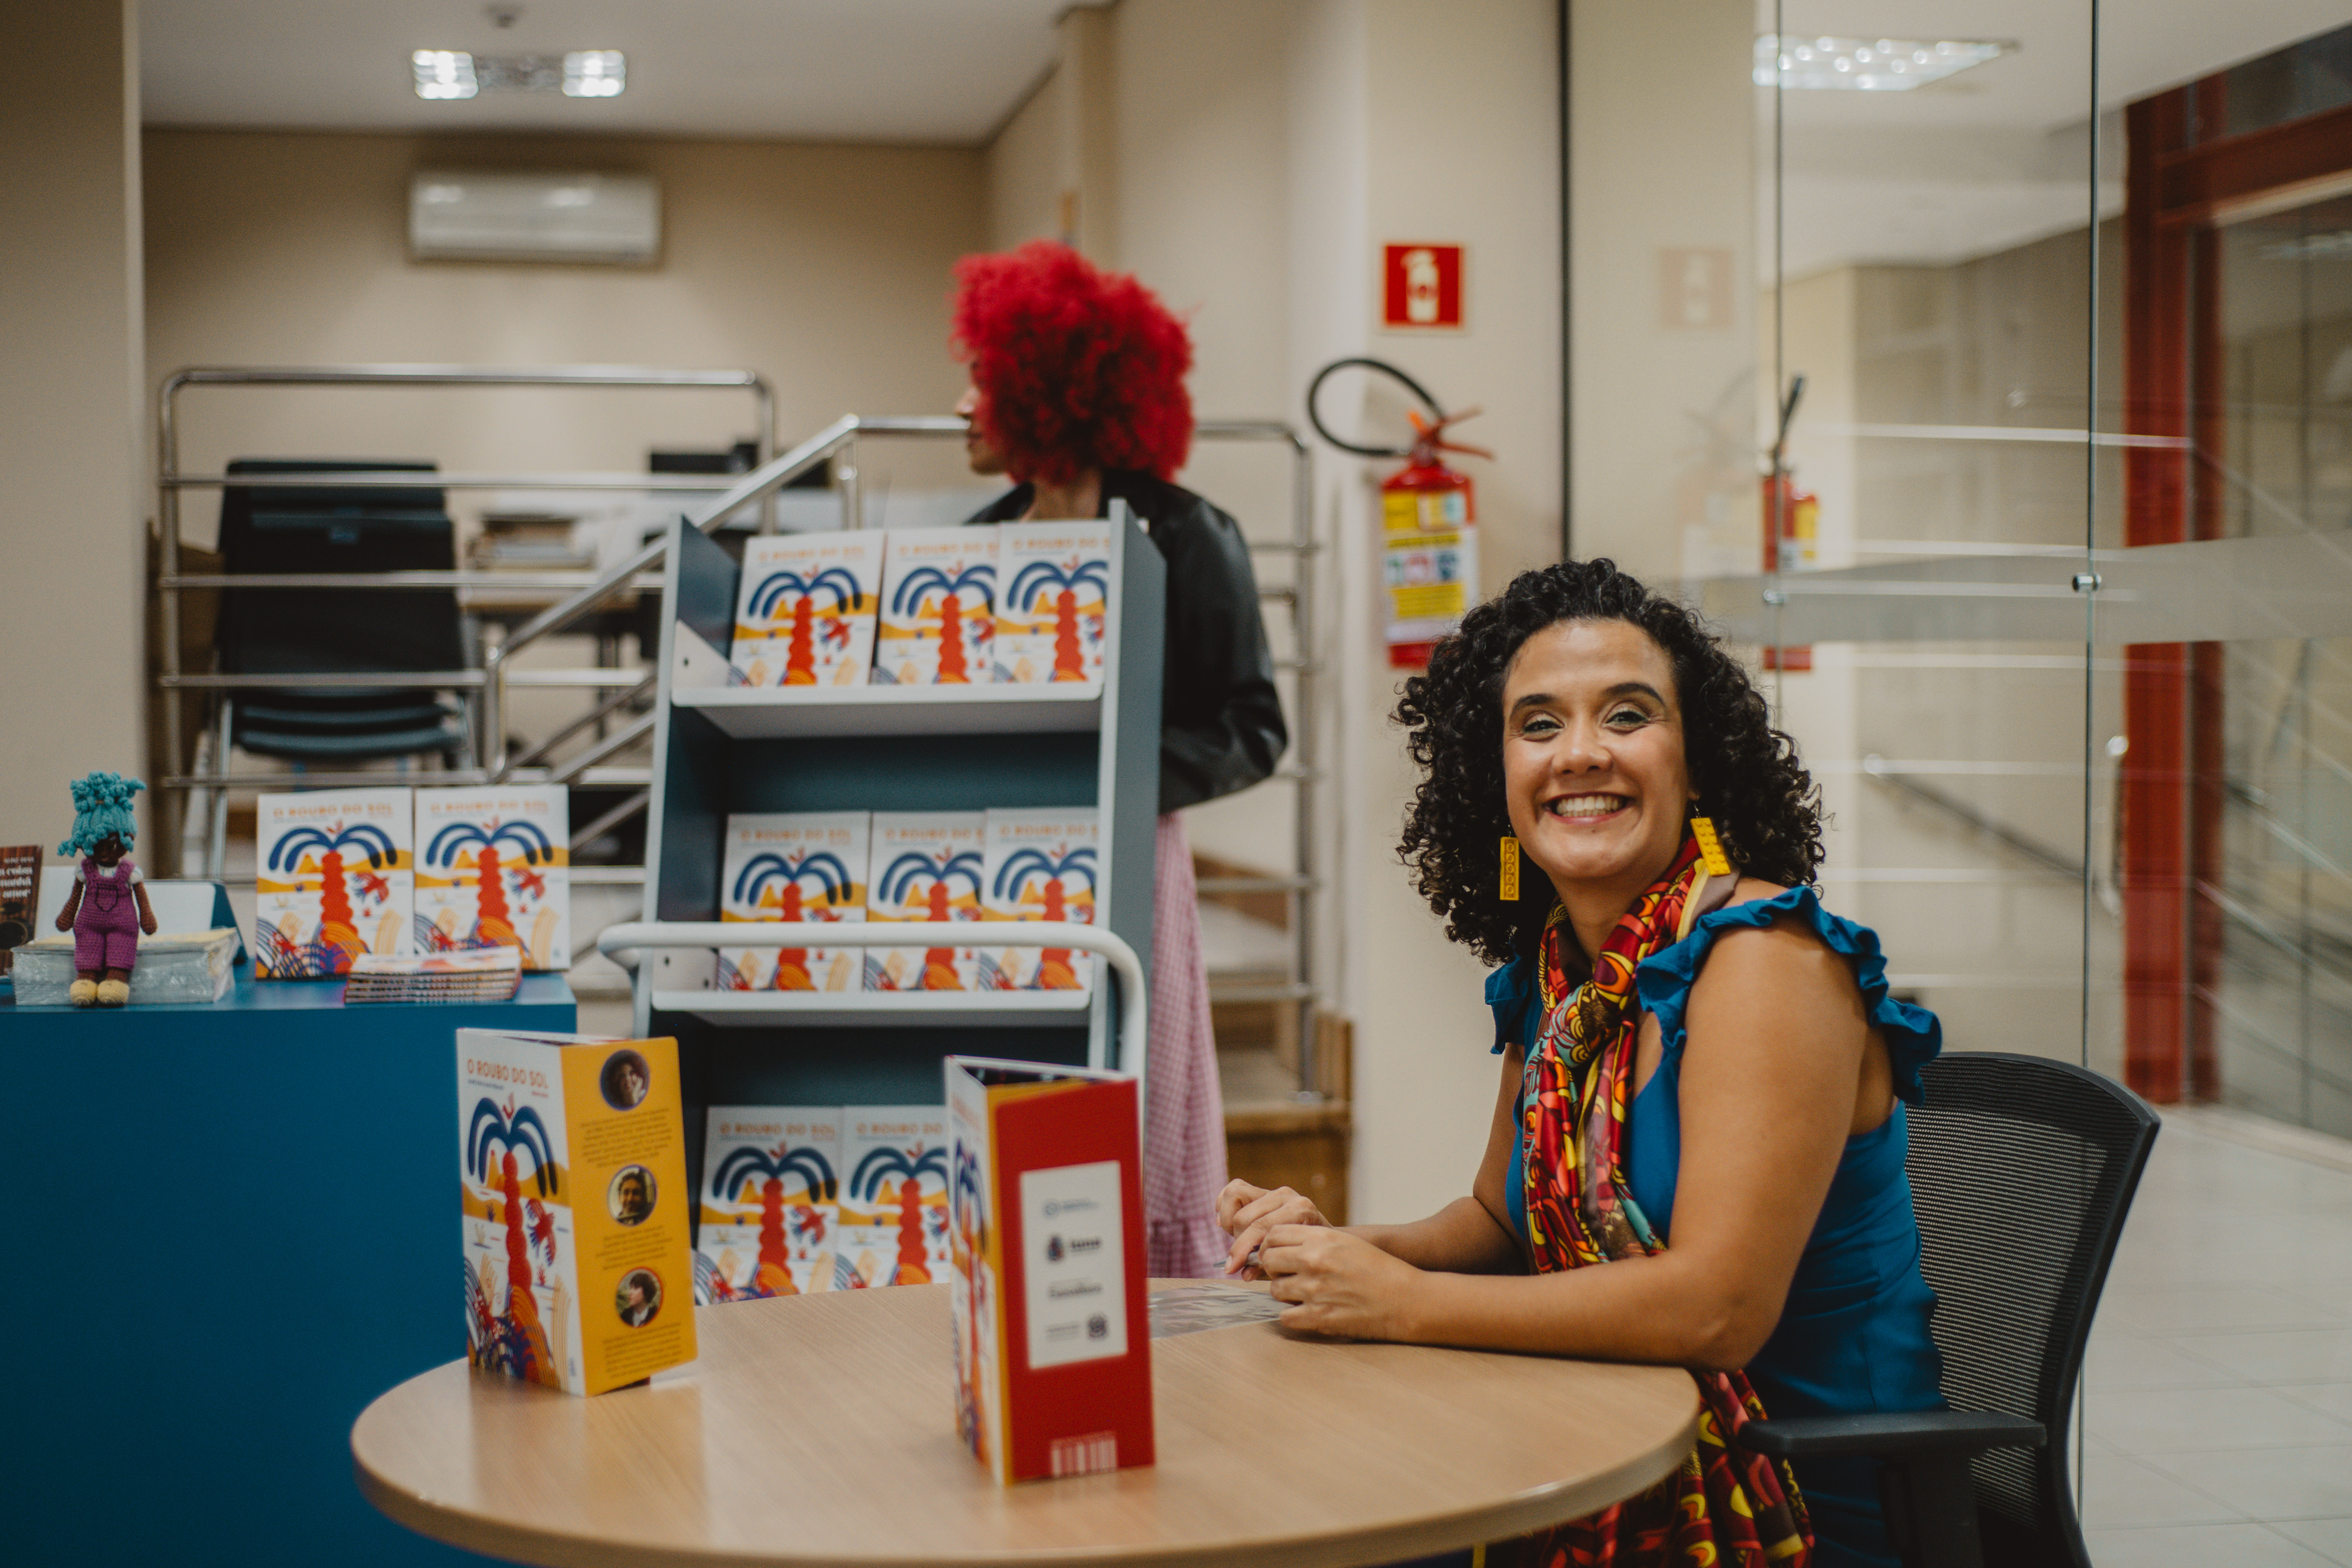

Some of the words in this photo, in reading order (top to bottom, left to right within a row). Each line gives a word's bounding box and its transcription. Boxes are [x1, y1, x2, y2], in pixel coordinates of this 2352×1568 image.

[467, 1058, 474, 1075] O
[477, 1060, 509, 1080] ROUBO
[511, 1067, 527, 1084] DO
[529, 1070, 548, 1088] SOL
